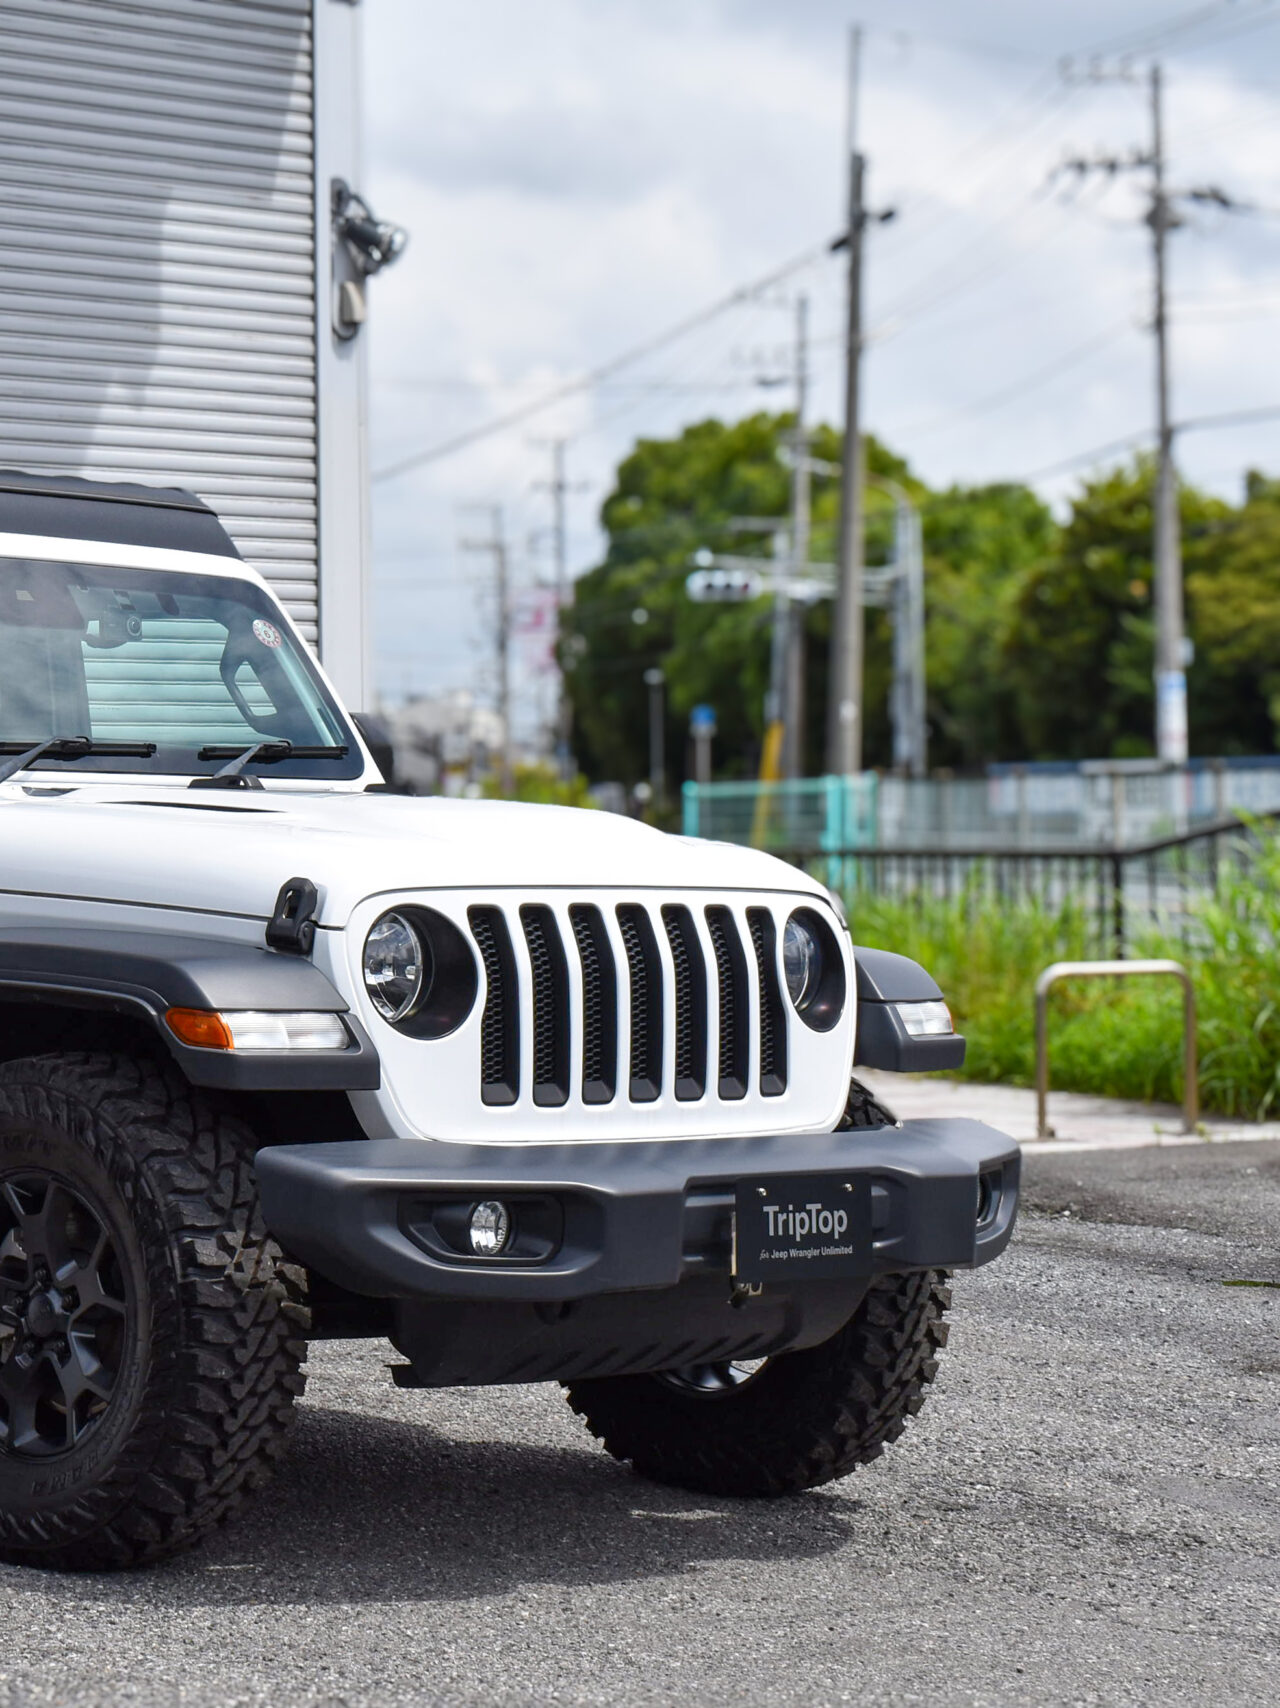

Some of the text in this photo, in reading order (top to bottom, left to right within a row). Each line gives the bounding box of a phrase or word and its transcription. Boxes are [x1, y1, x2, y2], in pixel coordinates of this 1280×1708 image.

[763, 1203, 848, 1242] TripTop
[771, 1249, 788, 1260] Jeep
[789, 1247, 820, 1259] Wrangler
[821, 1244, 853, 1256] Unlimited
